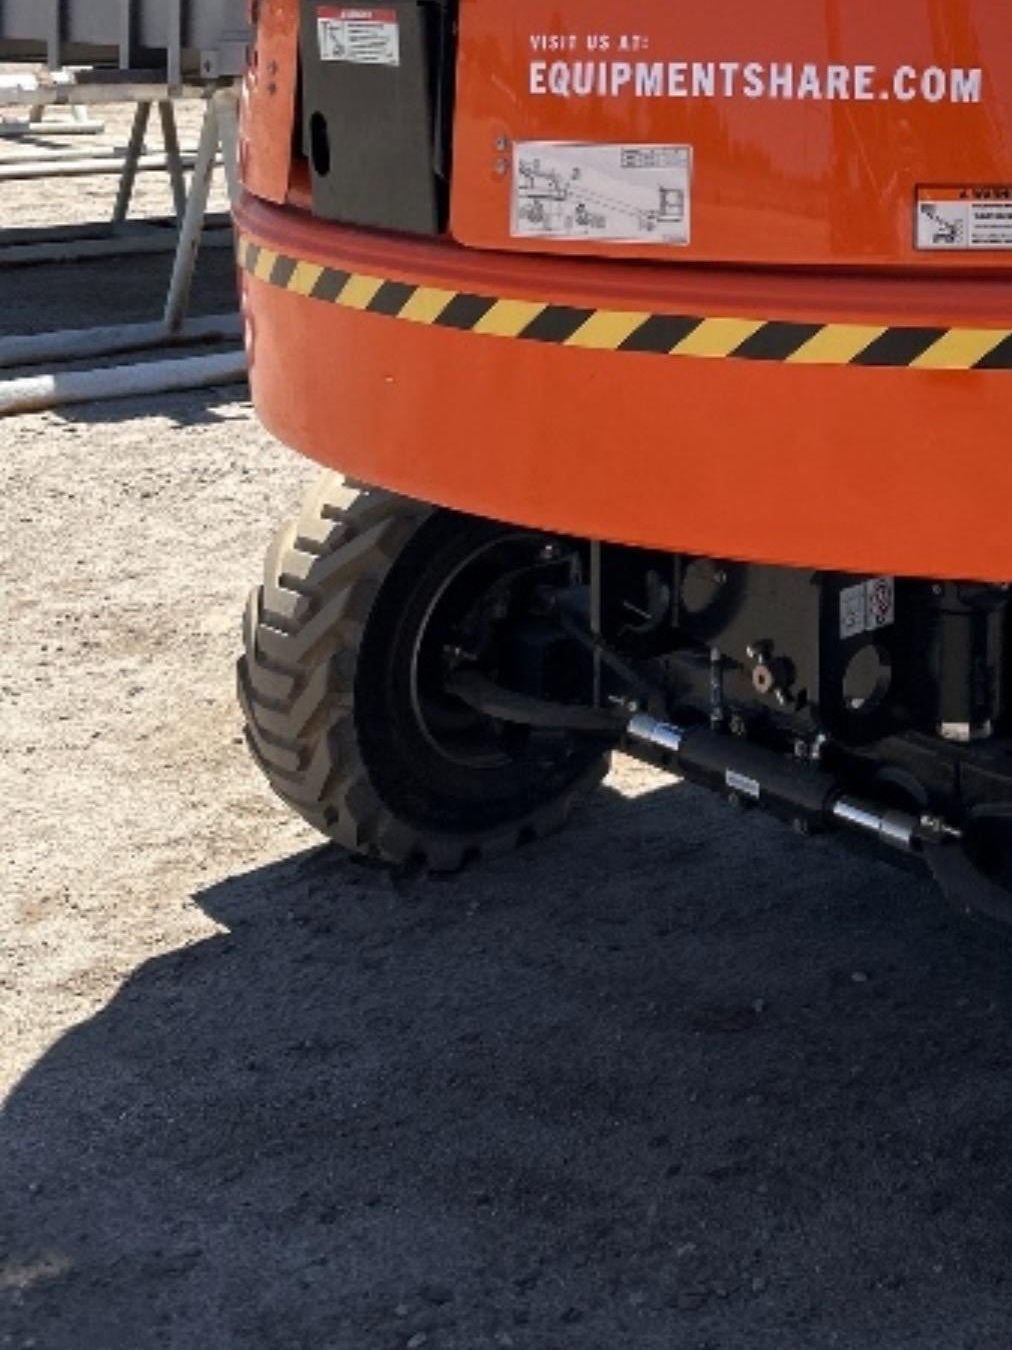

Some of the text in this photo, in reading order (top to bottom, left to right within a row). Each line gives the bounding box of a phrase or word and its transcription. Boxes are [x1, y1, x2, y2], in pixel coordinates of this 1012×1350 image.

[530, 34, 650, 52] VISIT US AT:
[529, 60, 983, 104] EQUIPMENTSHARE.COM
